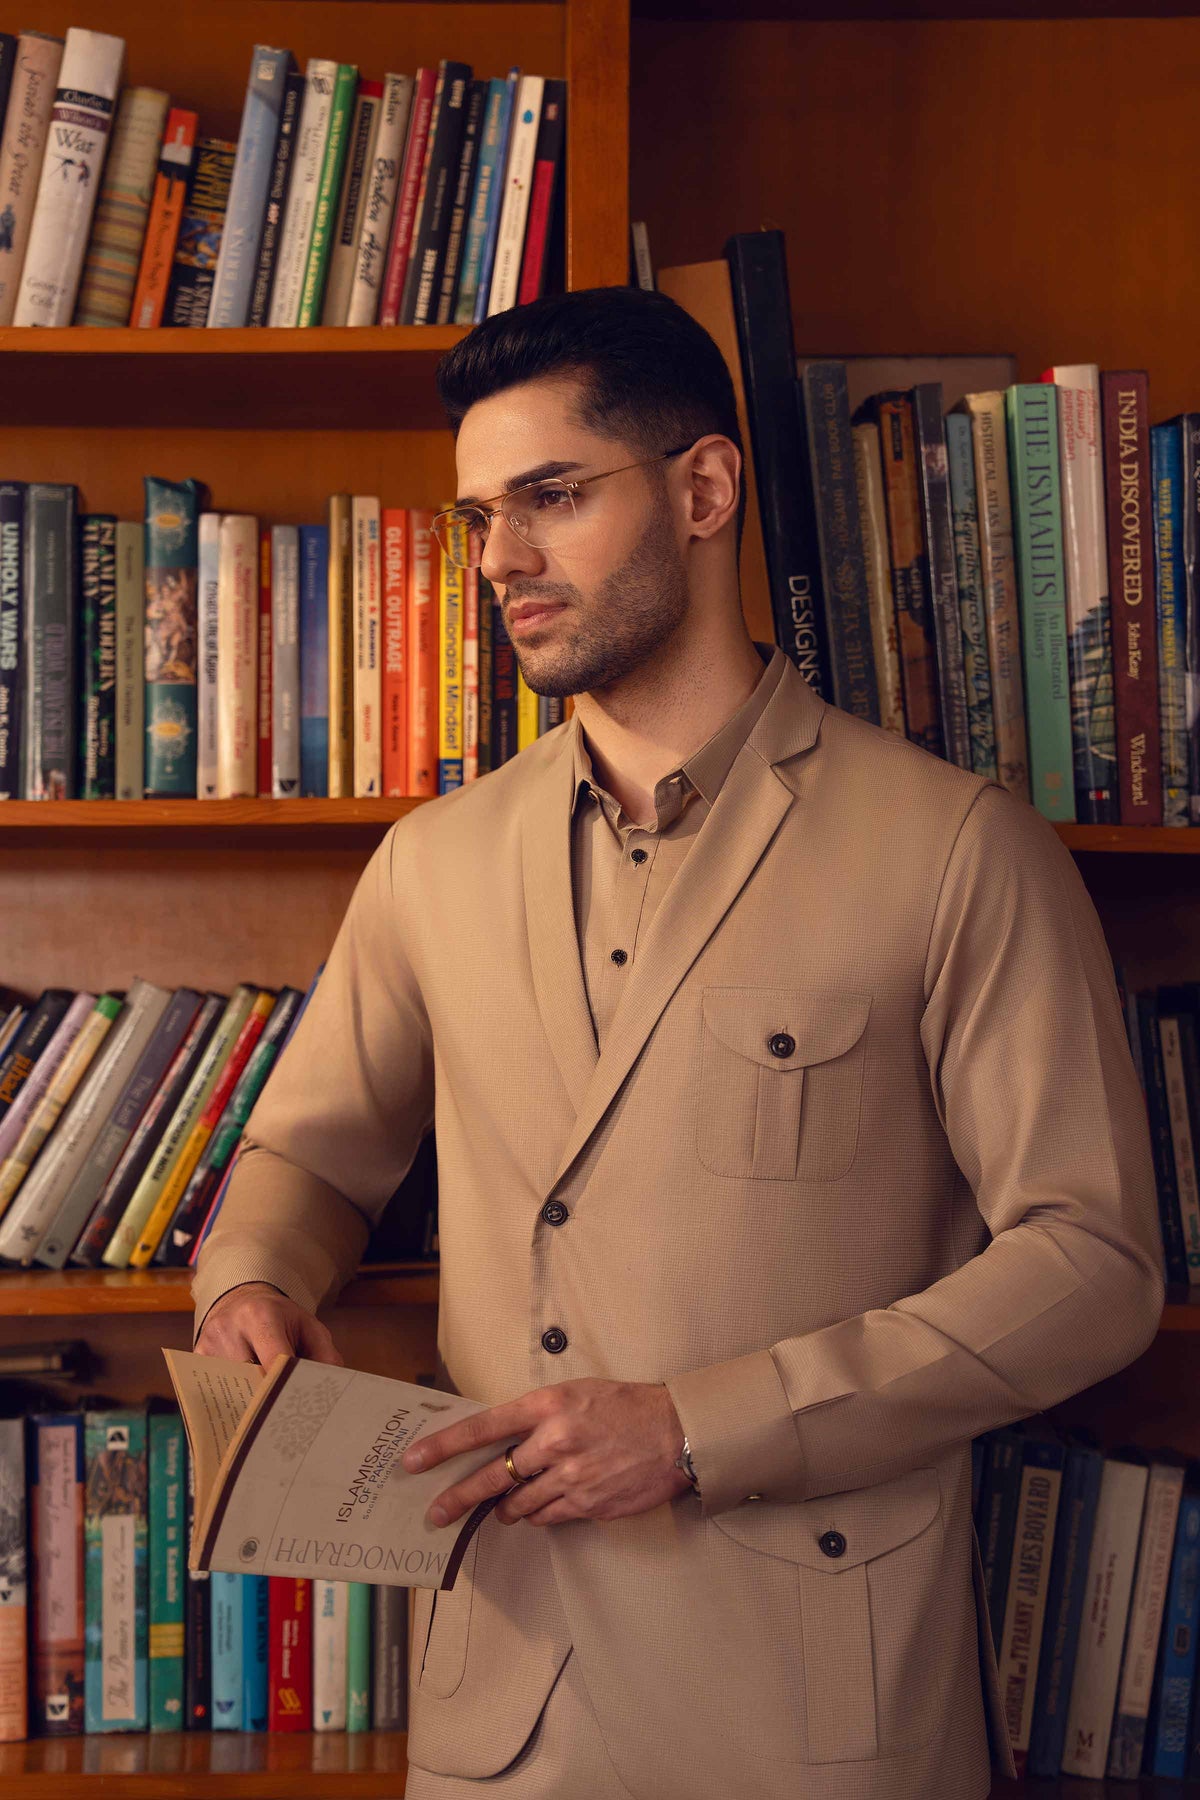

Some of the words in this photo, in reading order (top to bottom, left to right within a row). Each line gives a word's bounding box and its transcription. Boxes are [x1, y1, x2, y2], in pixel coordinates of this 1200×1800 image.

[54, 128, 96, 154] War
[310, 230, 324, 249] OF
[314, 199, 329, 229] GOD
[823, 417, 842, 456] BOOK
[1021, 392, 1053, 456] THE
[1060, 388, 1077, 461] Deutschland
[1072, 387, 1087, 440] Germany
[1116, 388, 1139, 459] INDIA
[979, 409, 999, 482] HISTORICAL
[985, 486, 1003, 528] ATLAS
[1022, 462, 1060, 599] ISMAILIS
[1117, 460, 1144, 608] DISCOVERED
[1, 521, 19, 603] UNHOLY
[81, 521, 99, 599] TURKEY
[98, 521, 116, 580] ISLAM
[385, 526, 401, 590] GLOBAL
[1159, 549, 1174, 560] &
[98, 583, 115, 606] IN
[834, 560, 862, 637] YEARS
[908, 566, 924, 609] GIFTS
[1159, 560, 1175, 601] PEOPLE
[124, 615, 135, 633] The
[385, 595, 401, 673] OUTRAGE
[444, 592, 461, 677] Millionaire
[789, 575, 818, 682] DESIGNS
[1030, 609, 1049, 660] History
[1048, 608, 1063, 629] An
[1125, 619, 1142, 650] John
[1160, 602, 1175, 616] IN
[1, 608, 18, 670] WARS
[44, 622, 66, 672] WORLD
[97, 607, 116, 693] MODERN
[844, 638, 867, 685] THE
[1124, 649, 1143, 682] Keay
[1047, 631, 1067, 702] Illustrated
[43, 676, 65, 731] ISLAMIC
[444, 683, 460, 750] Mindset
[43, 737, 64, 759] THE
[1128, 731, 1150, 808] Windward
[165, 1436, 178, 1476] Thirty
[336, 1408, 410, 1524] ISLAMISATION
[358, 1484, 372, 1505] OF
[368, 1427, 409, 1485] PAKISTANI
[166, 1482, 178, 1519] Years
[362, 1492, 380, 1521] Social
[1023, 1475, 1051, 1542] BOVARD
[166, 1525, 178, 1541] in
[273, 1537, 448, 1576] MONOGRAPH
[166, 1546, 179, 1603] Kashmir
[1017, 1543, 1042, 1597] JAMES
[1010, 1602, 1033, 1663] TYRANNY
[106, 1679, 129, 1707] The
